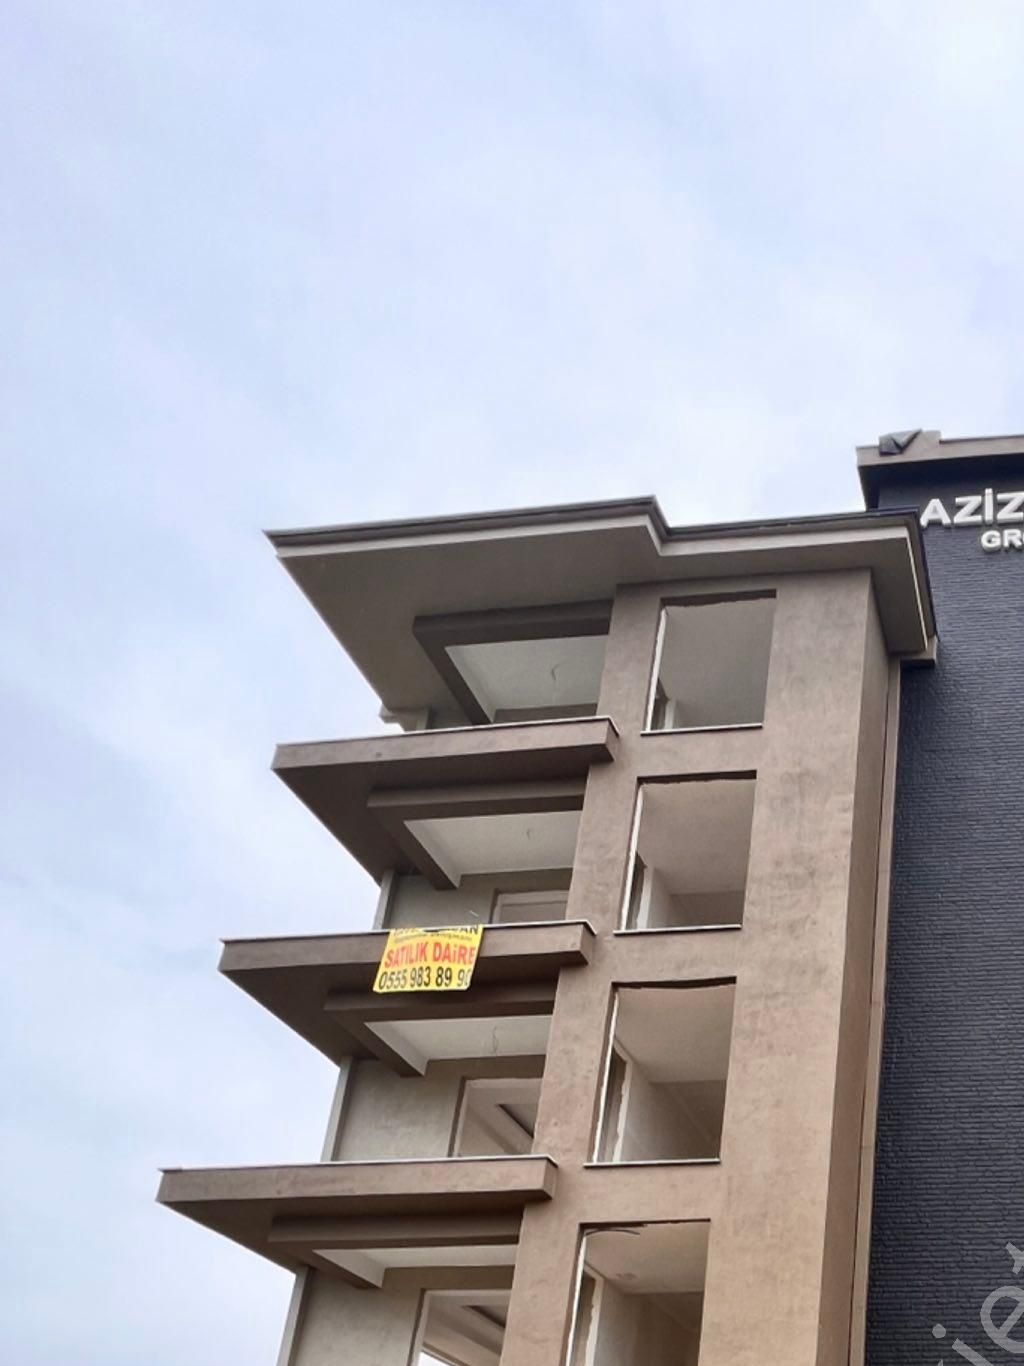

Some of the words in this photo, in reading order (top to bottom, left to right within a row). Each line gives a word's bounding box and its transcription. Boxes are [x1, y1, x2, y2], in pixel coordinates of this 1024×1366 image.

[385, 942, 429, 968] SATILIK
[379, 969, 408, 990] 0555
[410, 966, 431, 988] 983
[435, 966, 453, 987] 89
